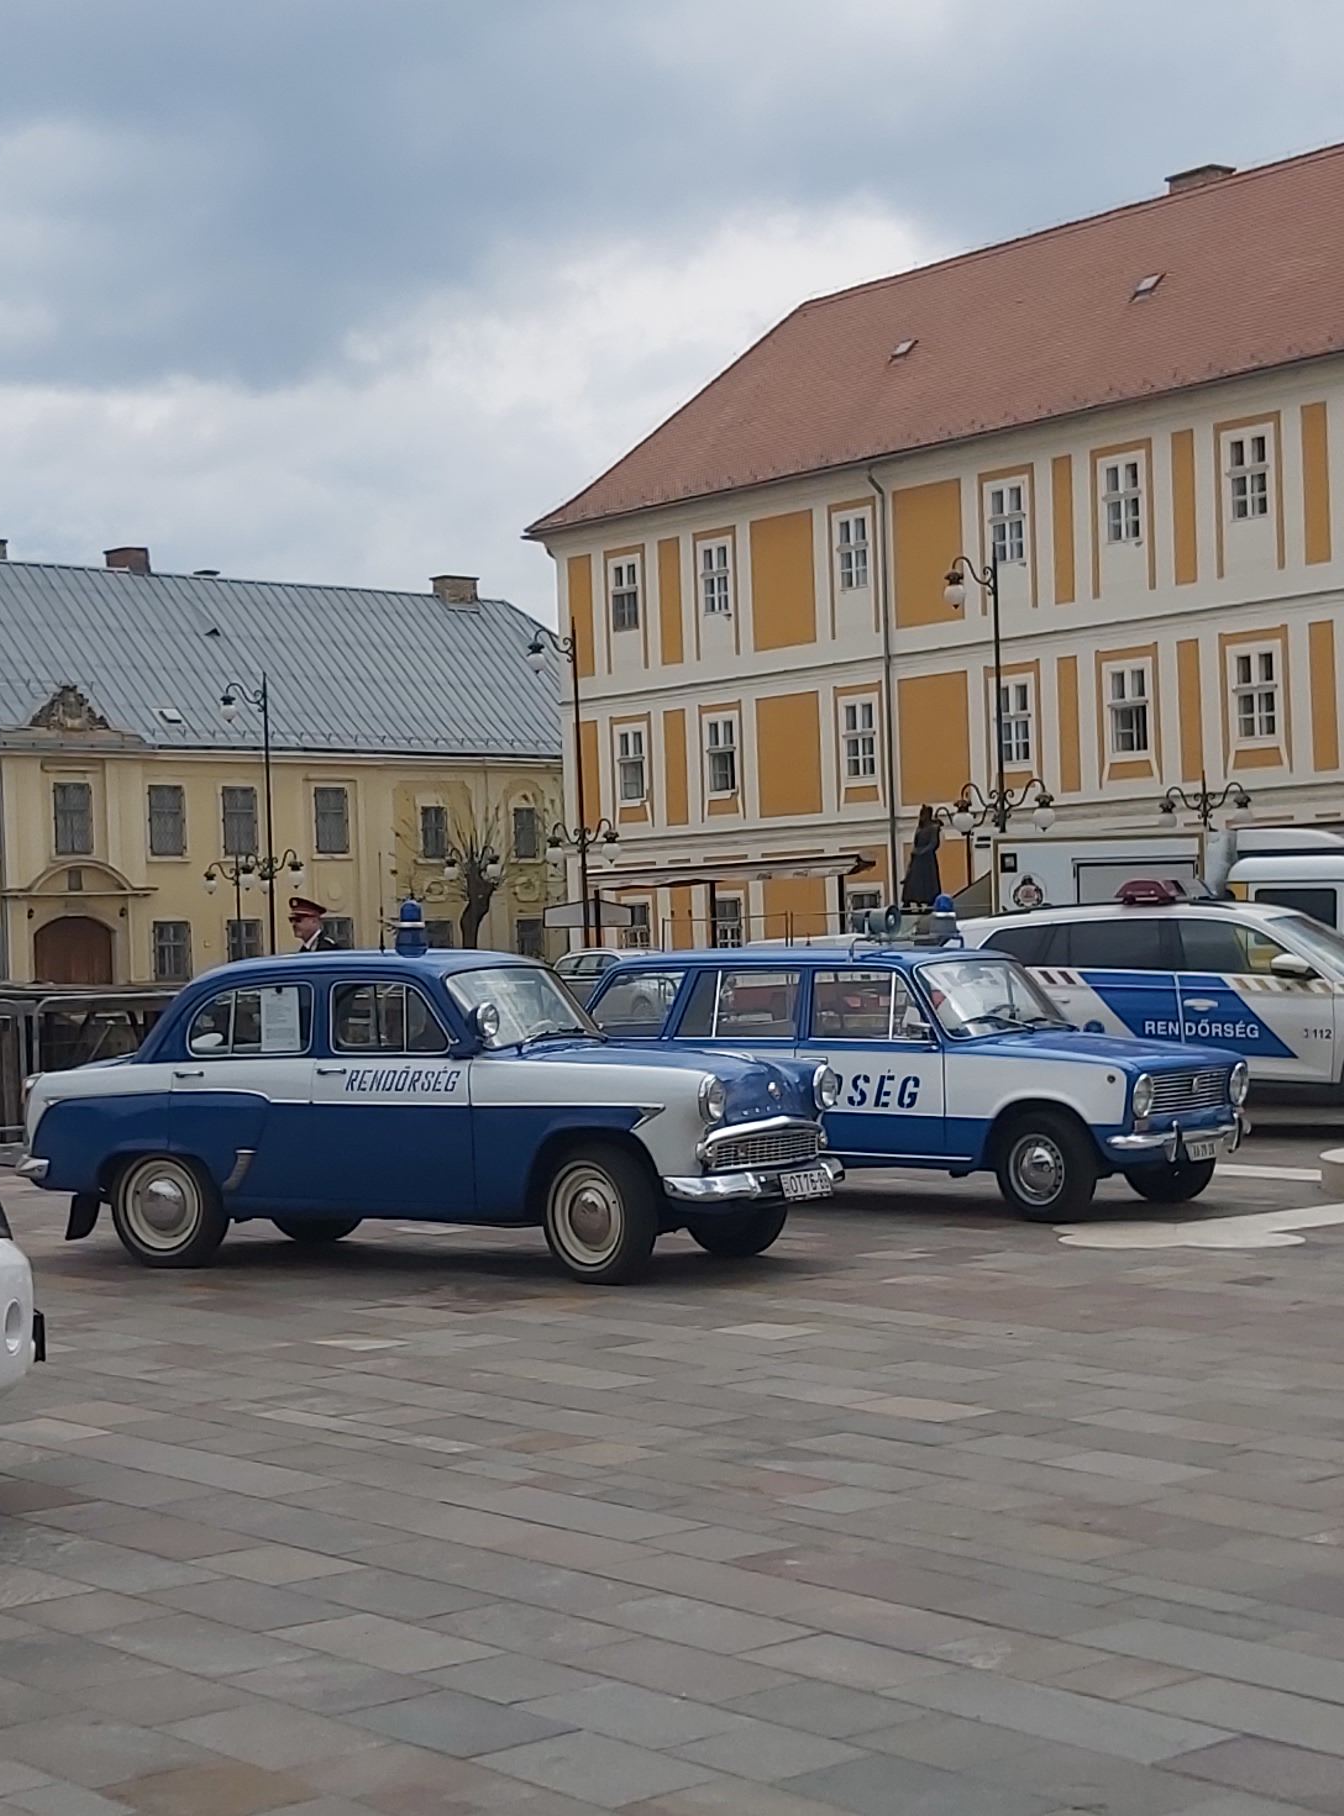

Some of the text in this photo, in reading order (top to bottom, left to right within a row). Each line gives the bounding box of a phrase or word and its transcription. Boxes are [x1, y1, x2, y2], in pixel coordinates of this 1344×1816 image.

[1144, 1018, 1260, 1039] RENDŐRSÉG
[1312, 1028, 1333, 1040] 112
[344, 1065, 462, 1093] RENDŐRSÉG
